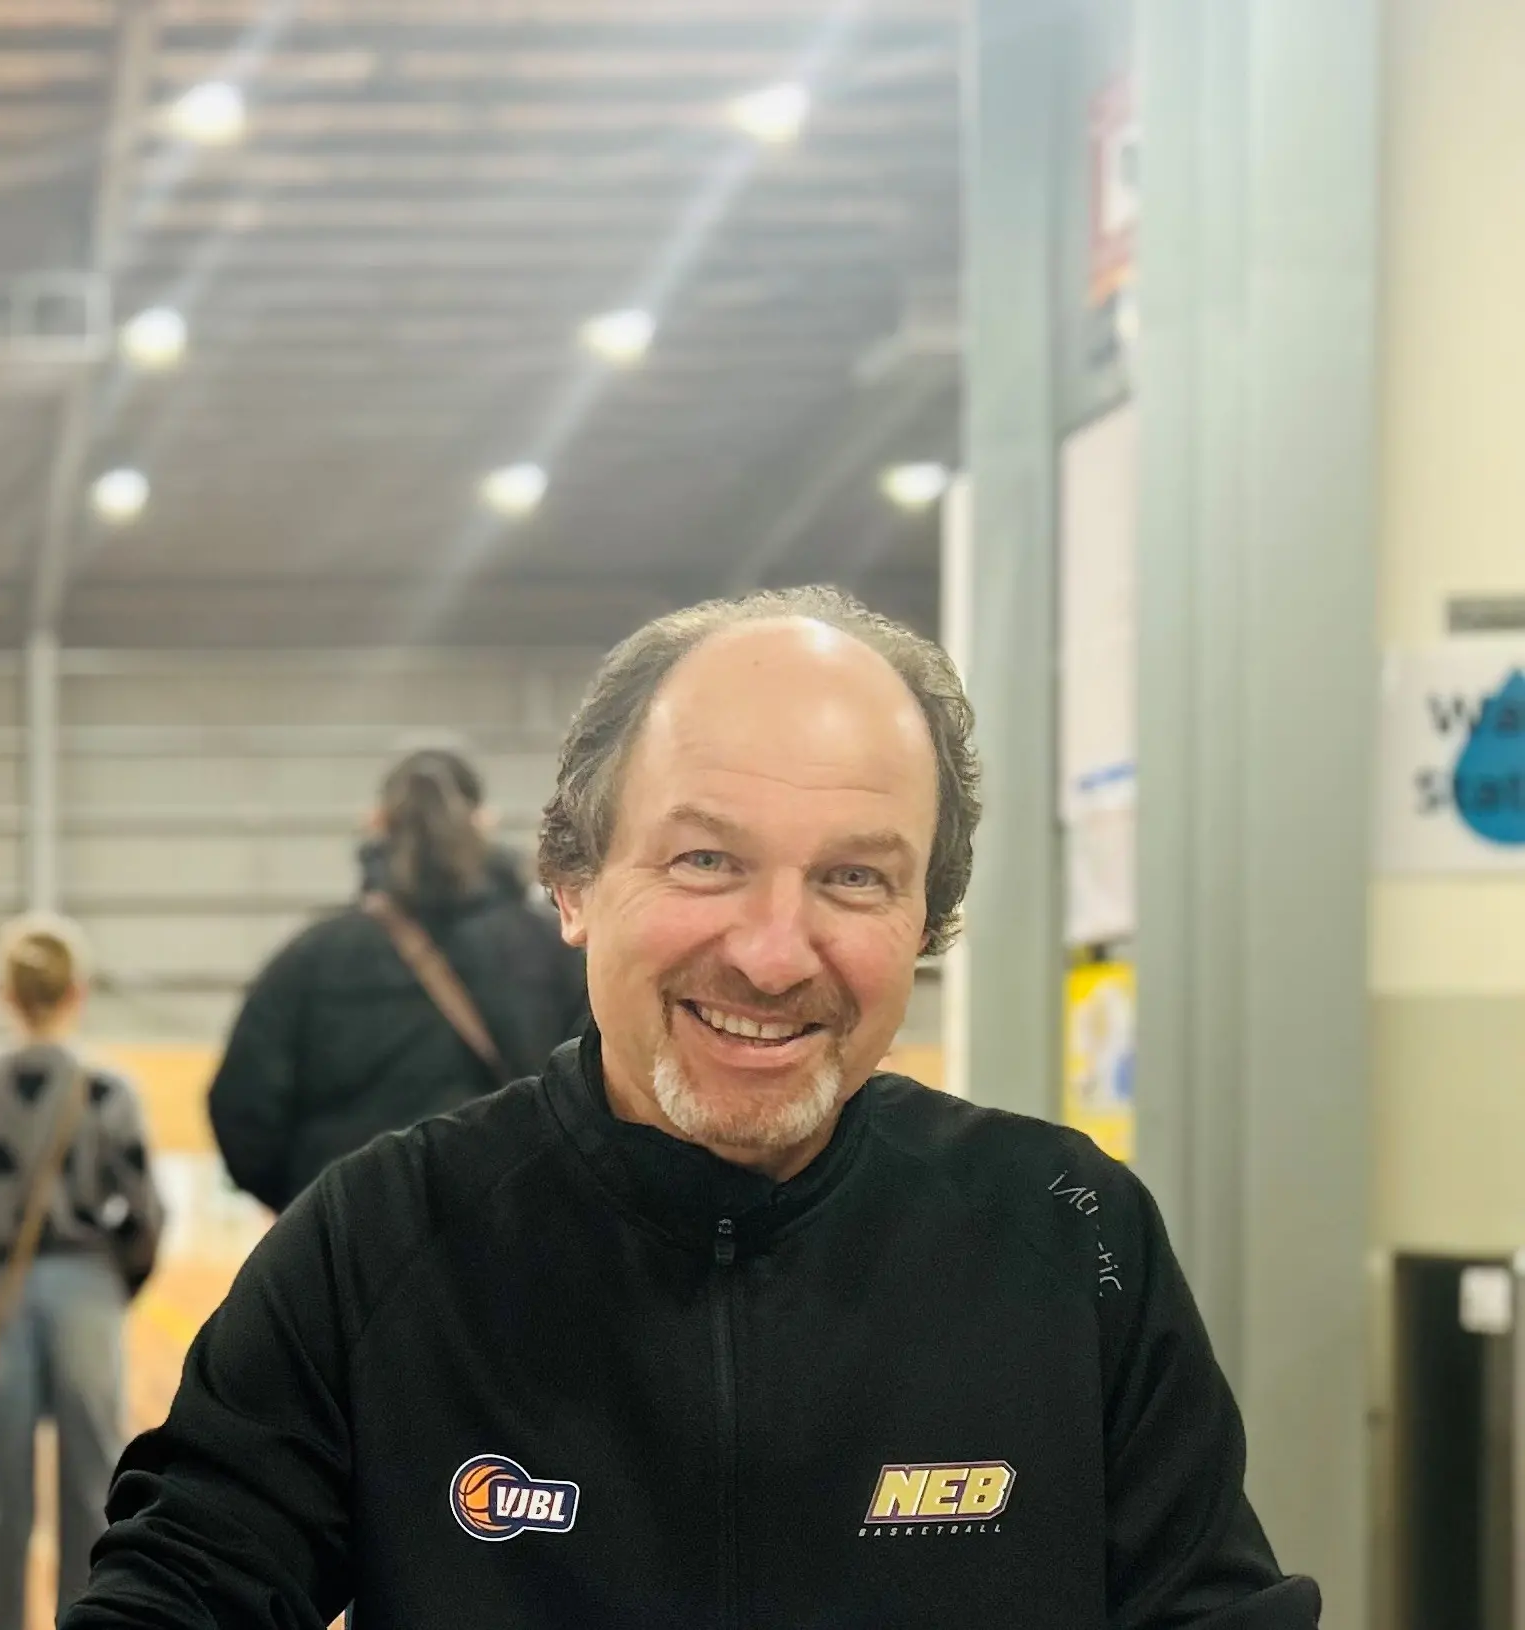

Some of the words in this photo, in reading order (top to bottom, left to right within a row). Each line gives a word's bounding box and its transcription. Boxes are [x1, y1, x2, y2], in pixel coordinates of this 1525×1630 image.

[496, 1486, 565, 1521] VJBL
[872, 1466, 1011, 1517] NEB
[858, 1524, 1001, 1537] BASKETBALL
